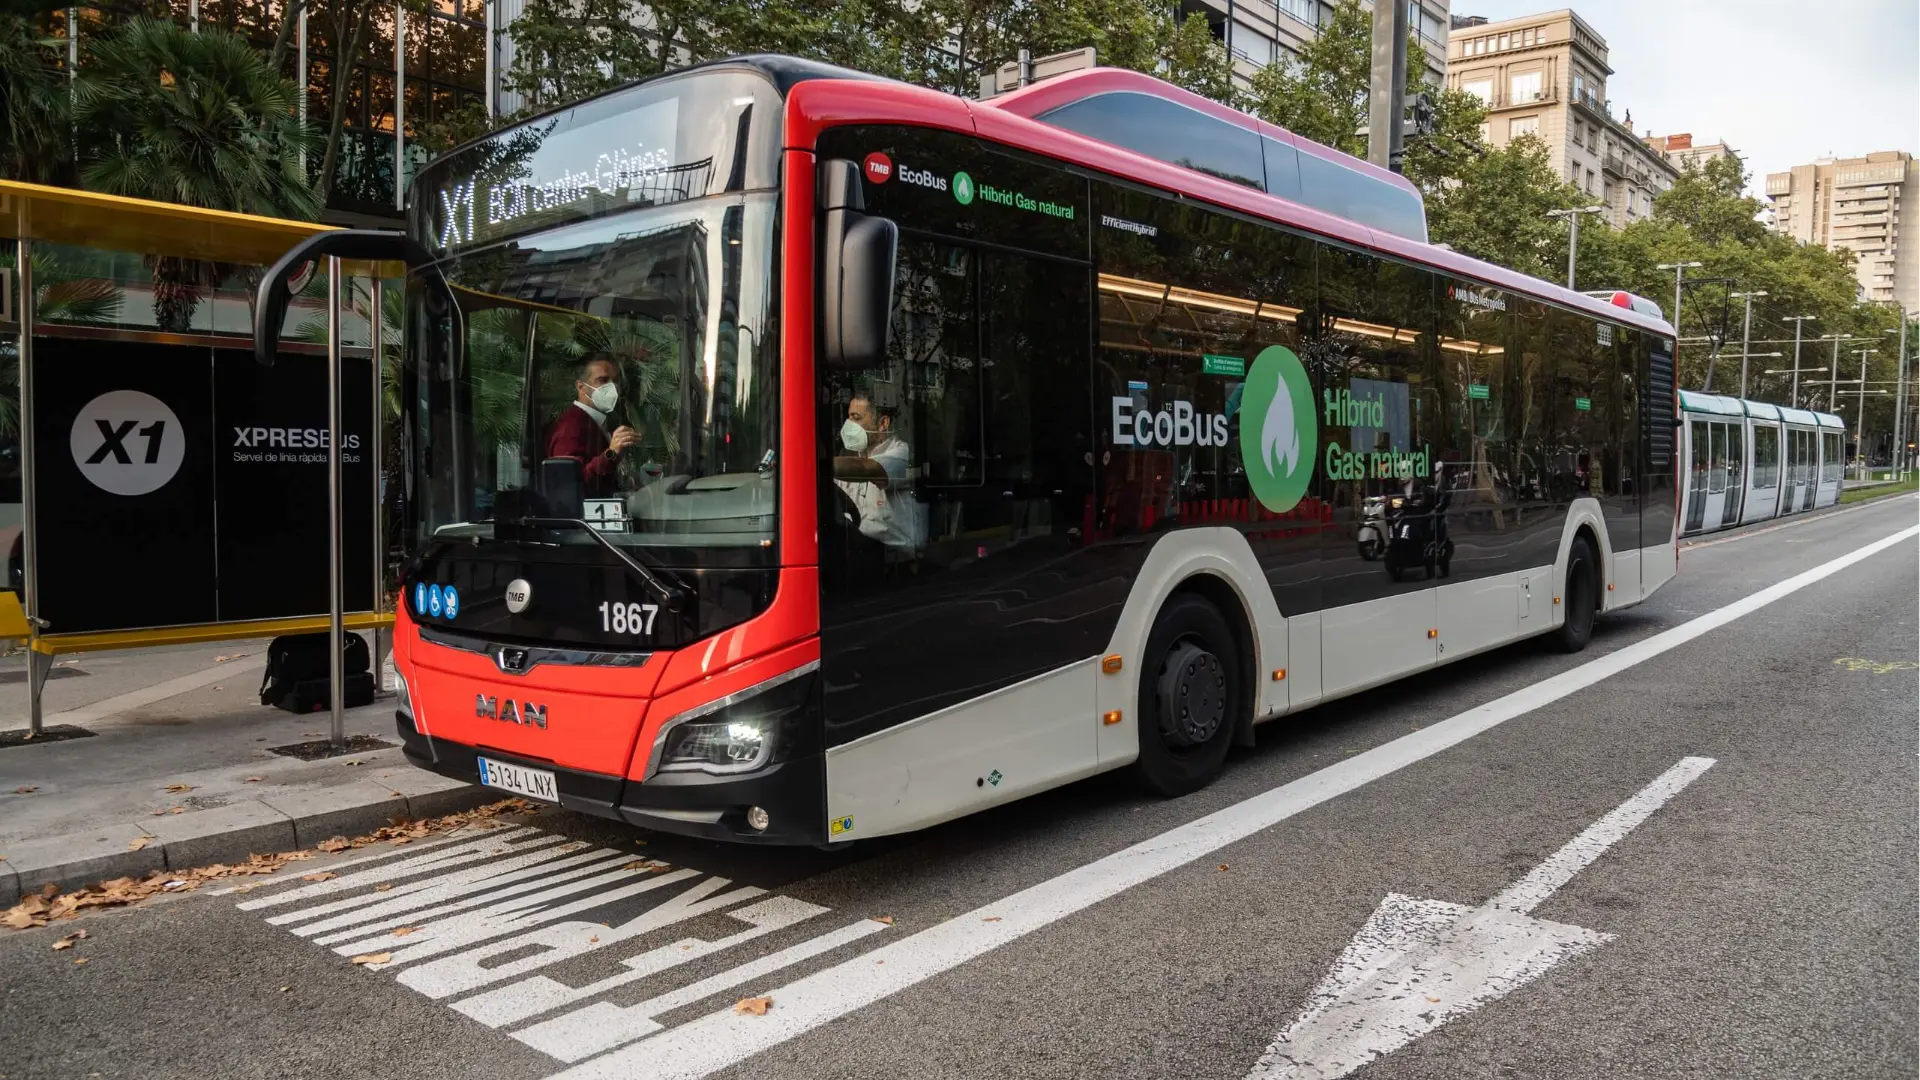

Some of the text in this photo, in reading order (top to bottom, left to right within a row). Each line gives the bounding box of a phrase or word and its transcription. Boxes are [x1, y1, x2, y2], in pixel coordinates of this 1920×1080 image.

[869, 162, 890, 176] TMB
[899, 164, 947, 191] EcoBus
[440, 174, 476, 248] X1
[979, 183, 1074, 220] Híbrid Gas natural
[1112, 395, 1229, 447] EcoBus
[1324, 387, 1385, 428] Híbrid
[85, 419, 166, 465] X1
[233, 451, 263, 463] Servei
[264, 452, 278, 462] de
[298, 452, 327, 464] ràpida
[342, 453, 360, 463] Bus
[1326, 442, 1429, 481] Gas natural
[507, 591, 525, 603] TMB
[599, 601, 659, 635] 1867
[476, 694, 549, 730] MAN
[488, 763, 522, 791] 5134
[524, 771, 555, 798] LNX
